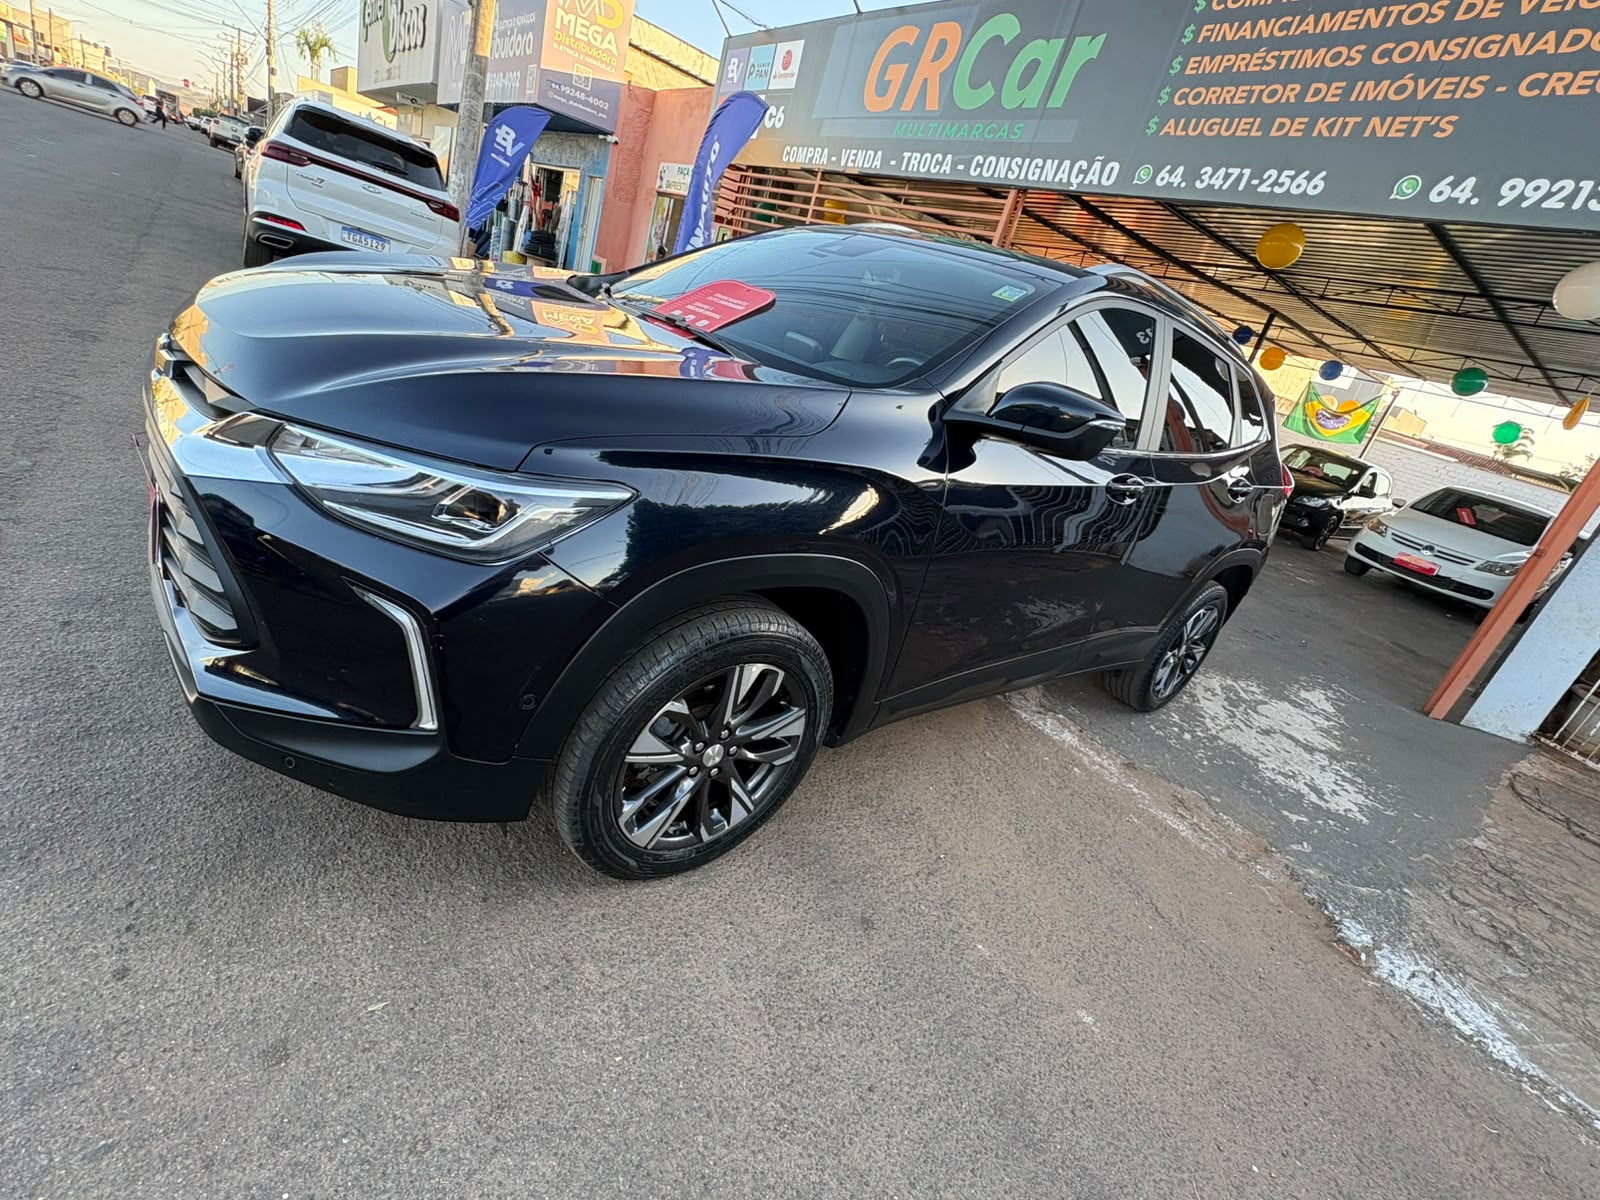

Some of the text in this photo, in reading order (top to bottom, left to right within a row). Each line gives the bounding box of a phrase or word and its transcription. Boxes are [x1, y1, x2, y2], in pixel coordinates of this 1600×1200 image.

[555, 7, 618, 56] MEGA
[1197, 0, 1451, 43] FINANCIAMENTOS
[1453, 0, 1504, 21] DE
[554, 29, 617, 66] Distribuidora
[863, 13, 1108, 112] GRCar
[1184, 45, 1367, 75] EMPRÉSTIMOS
[755, 69, 769, 79] PAN
[1173, 84, 1301, 106] CORRETOR
[1304, 81, 1347, 103] DE
[1349, 73, 1491, 102] IMÓVEIS
[1518, 70, 1600, 97] CRE
[765, 105, 785, 128] C6
[893, 122, 1025, 140] MULTIMARCAS
[1159, 117, 1262, 137] ALUGUEL
[1269, 117, 1309, 137] DE
[1312, 117, 1362, 137] KIT
[1363, 115, 1460, 138] NET'S
[495, 124, 525, 157] BV
[782, 145, 829, 165] COMPRA
[840, 149, 883, 169] VENDA
[901, 152, 952, 174] TROCA
[969, 155, 1120, 190] CONSIGNAÇÃO
[1155, 165, 1186, 188] 64.
[1195, 166, 1327, 196] 3471-2566
[1429, 175, 1479, 205] 64.
